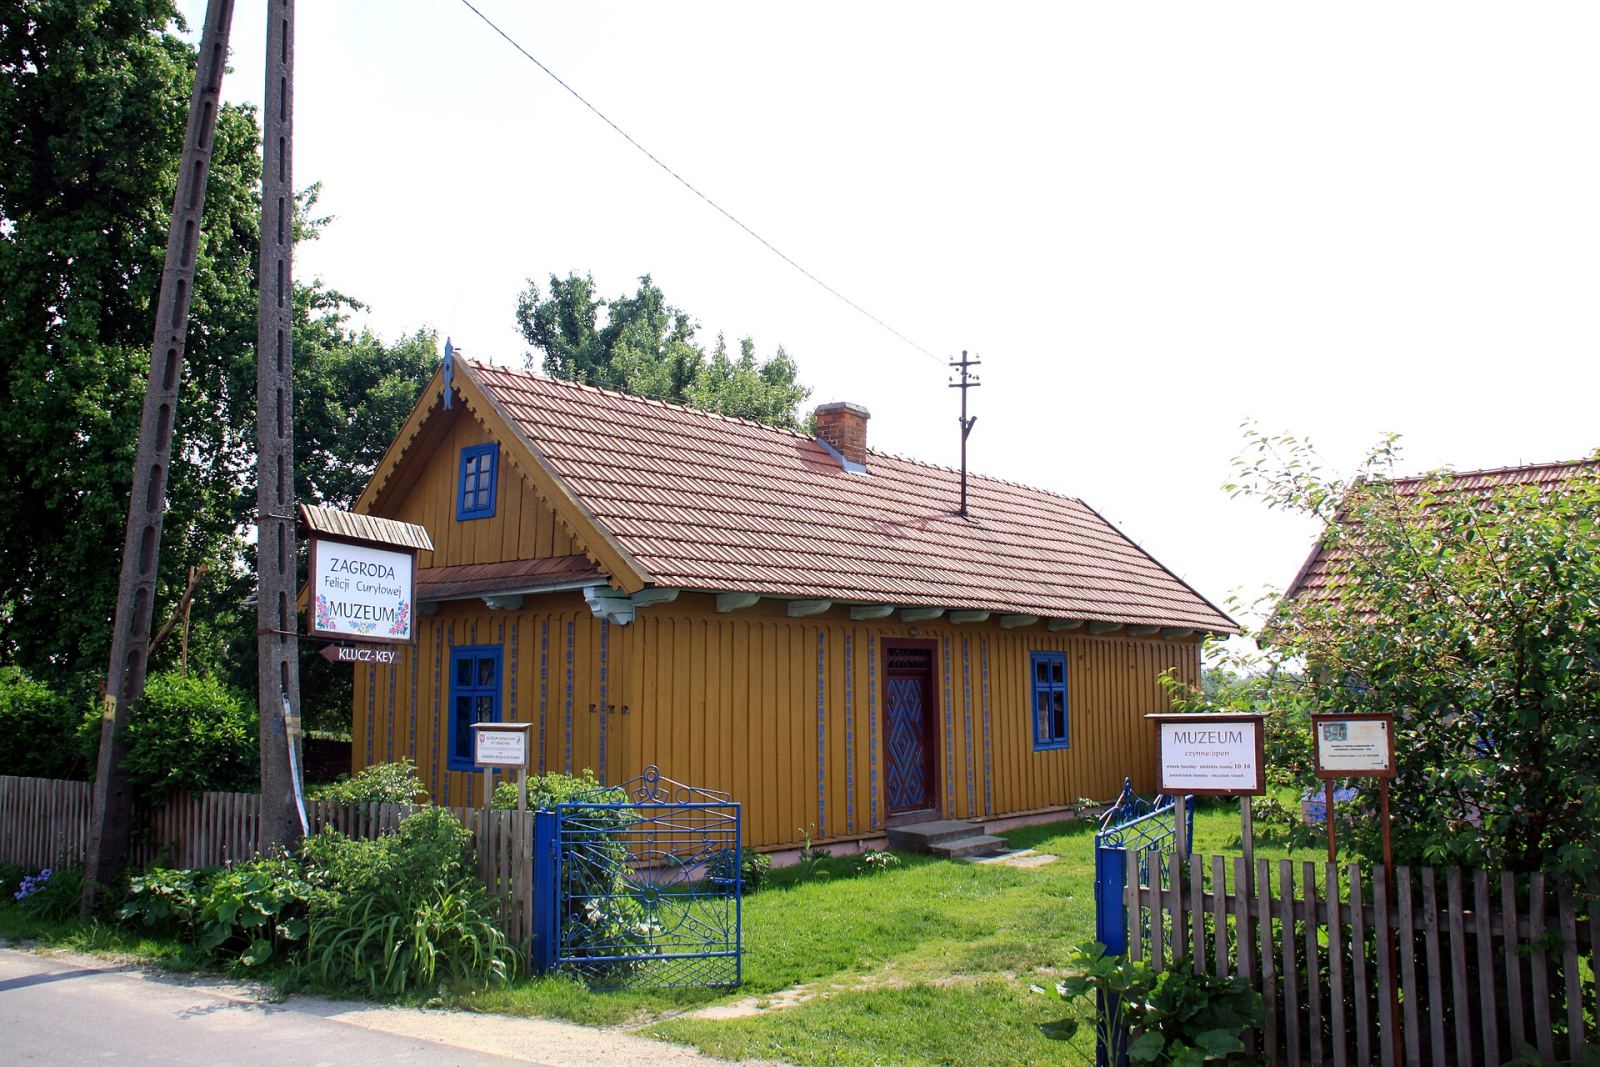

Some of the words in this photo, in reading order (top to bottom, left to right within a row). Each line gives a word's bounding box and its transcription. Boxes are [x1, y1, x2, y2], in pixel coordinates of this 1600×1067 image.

[330, 557, 396, 580] ZAGRODA
[324, 576, 350, 591] Felicji
[356, 580, 402, 598] Curyłowej
[329, 600, 395, 623] MUZEUM
[1173, 731, 1243, 744] MUZEUM
